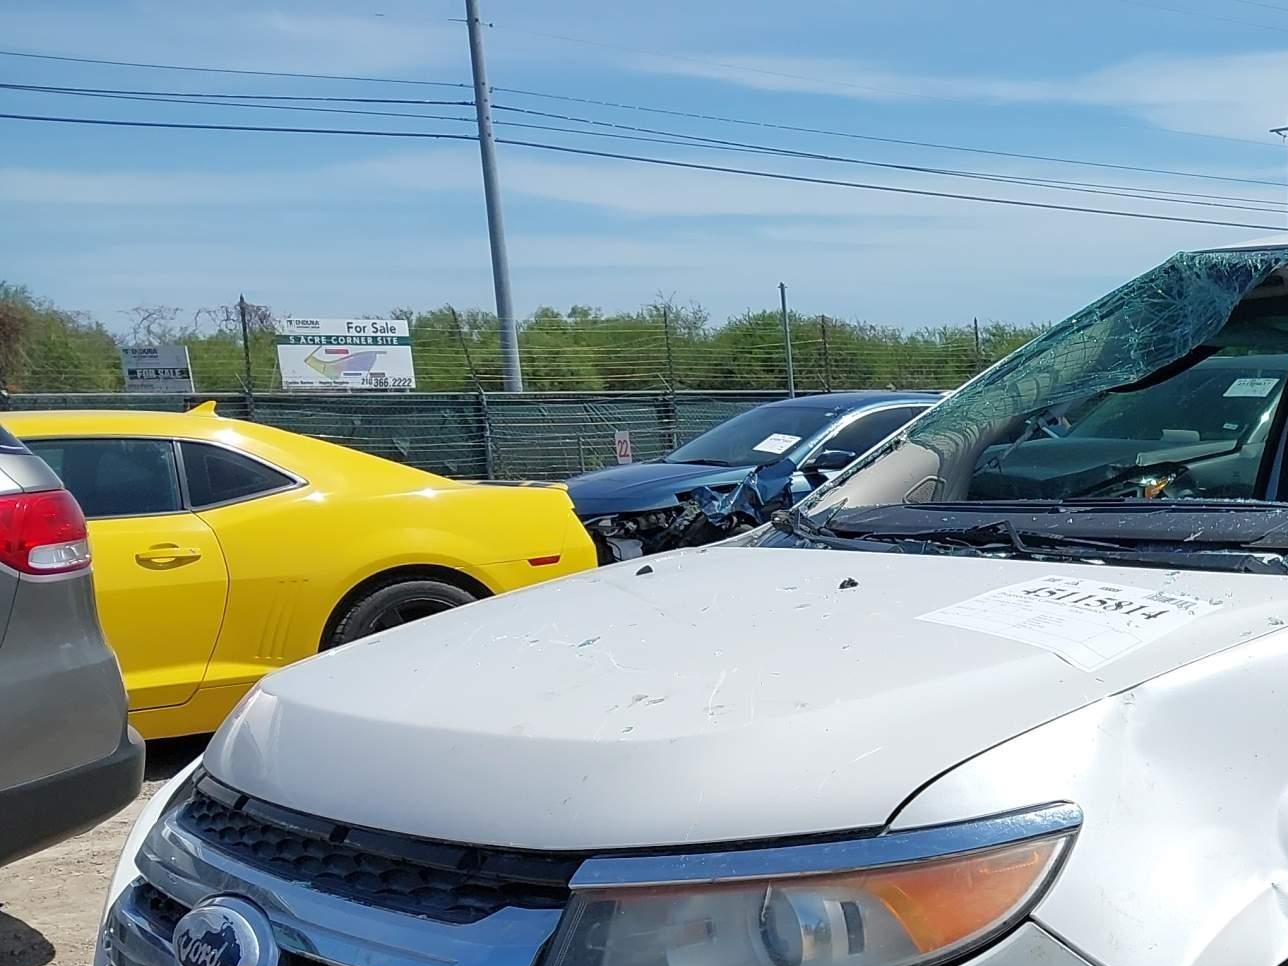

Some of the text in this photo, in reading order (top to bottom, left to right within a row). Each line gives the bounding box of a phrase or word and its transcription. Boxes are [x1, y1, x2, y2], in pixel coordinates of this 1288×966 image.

[346, 322, 397, 334] For Sale
[136, 369, 181, 379] FOR SALE
[617, 439, 631, 458] 22
[1022, 585, 1171, 621] 45115814
